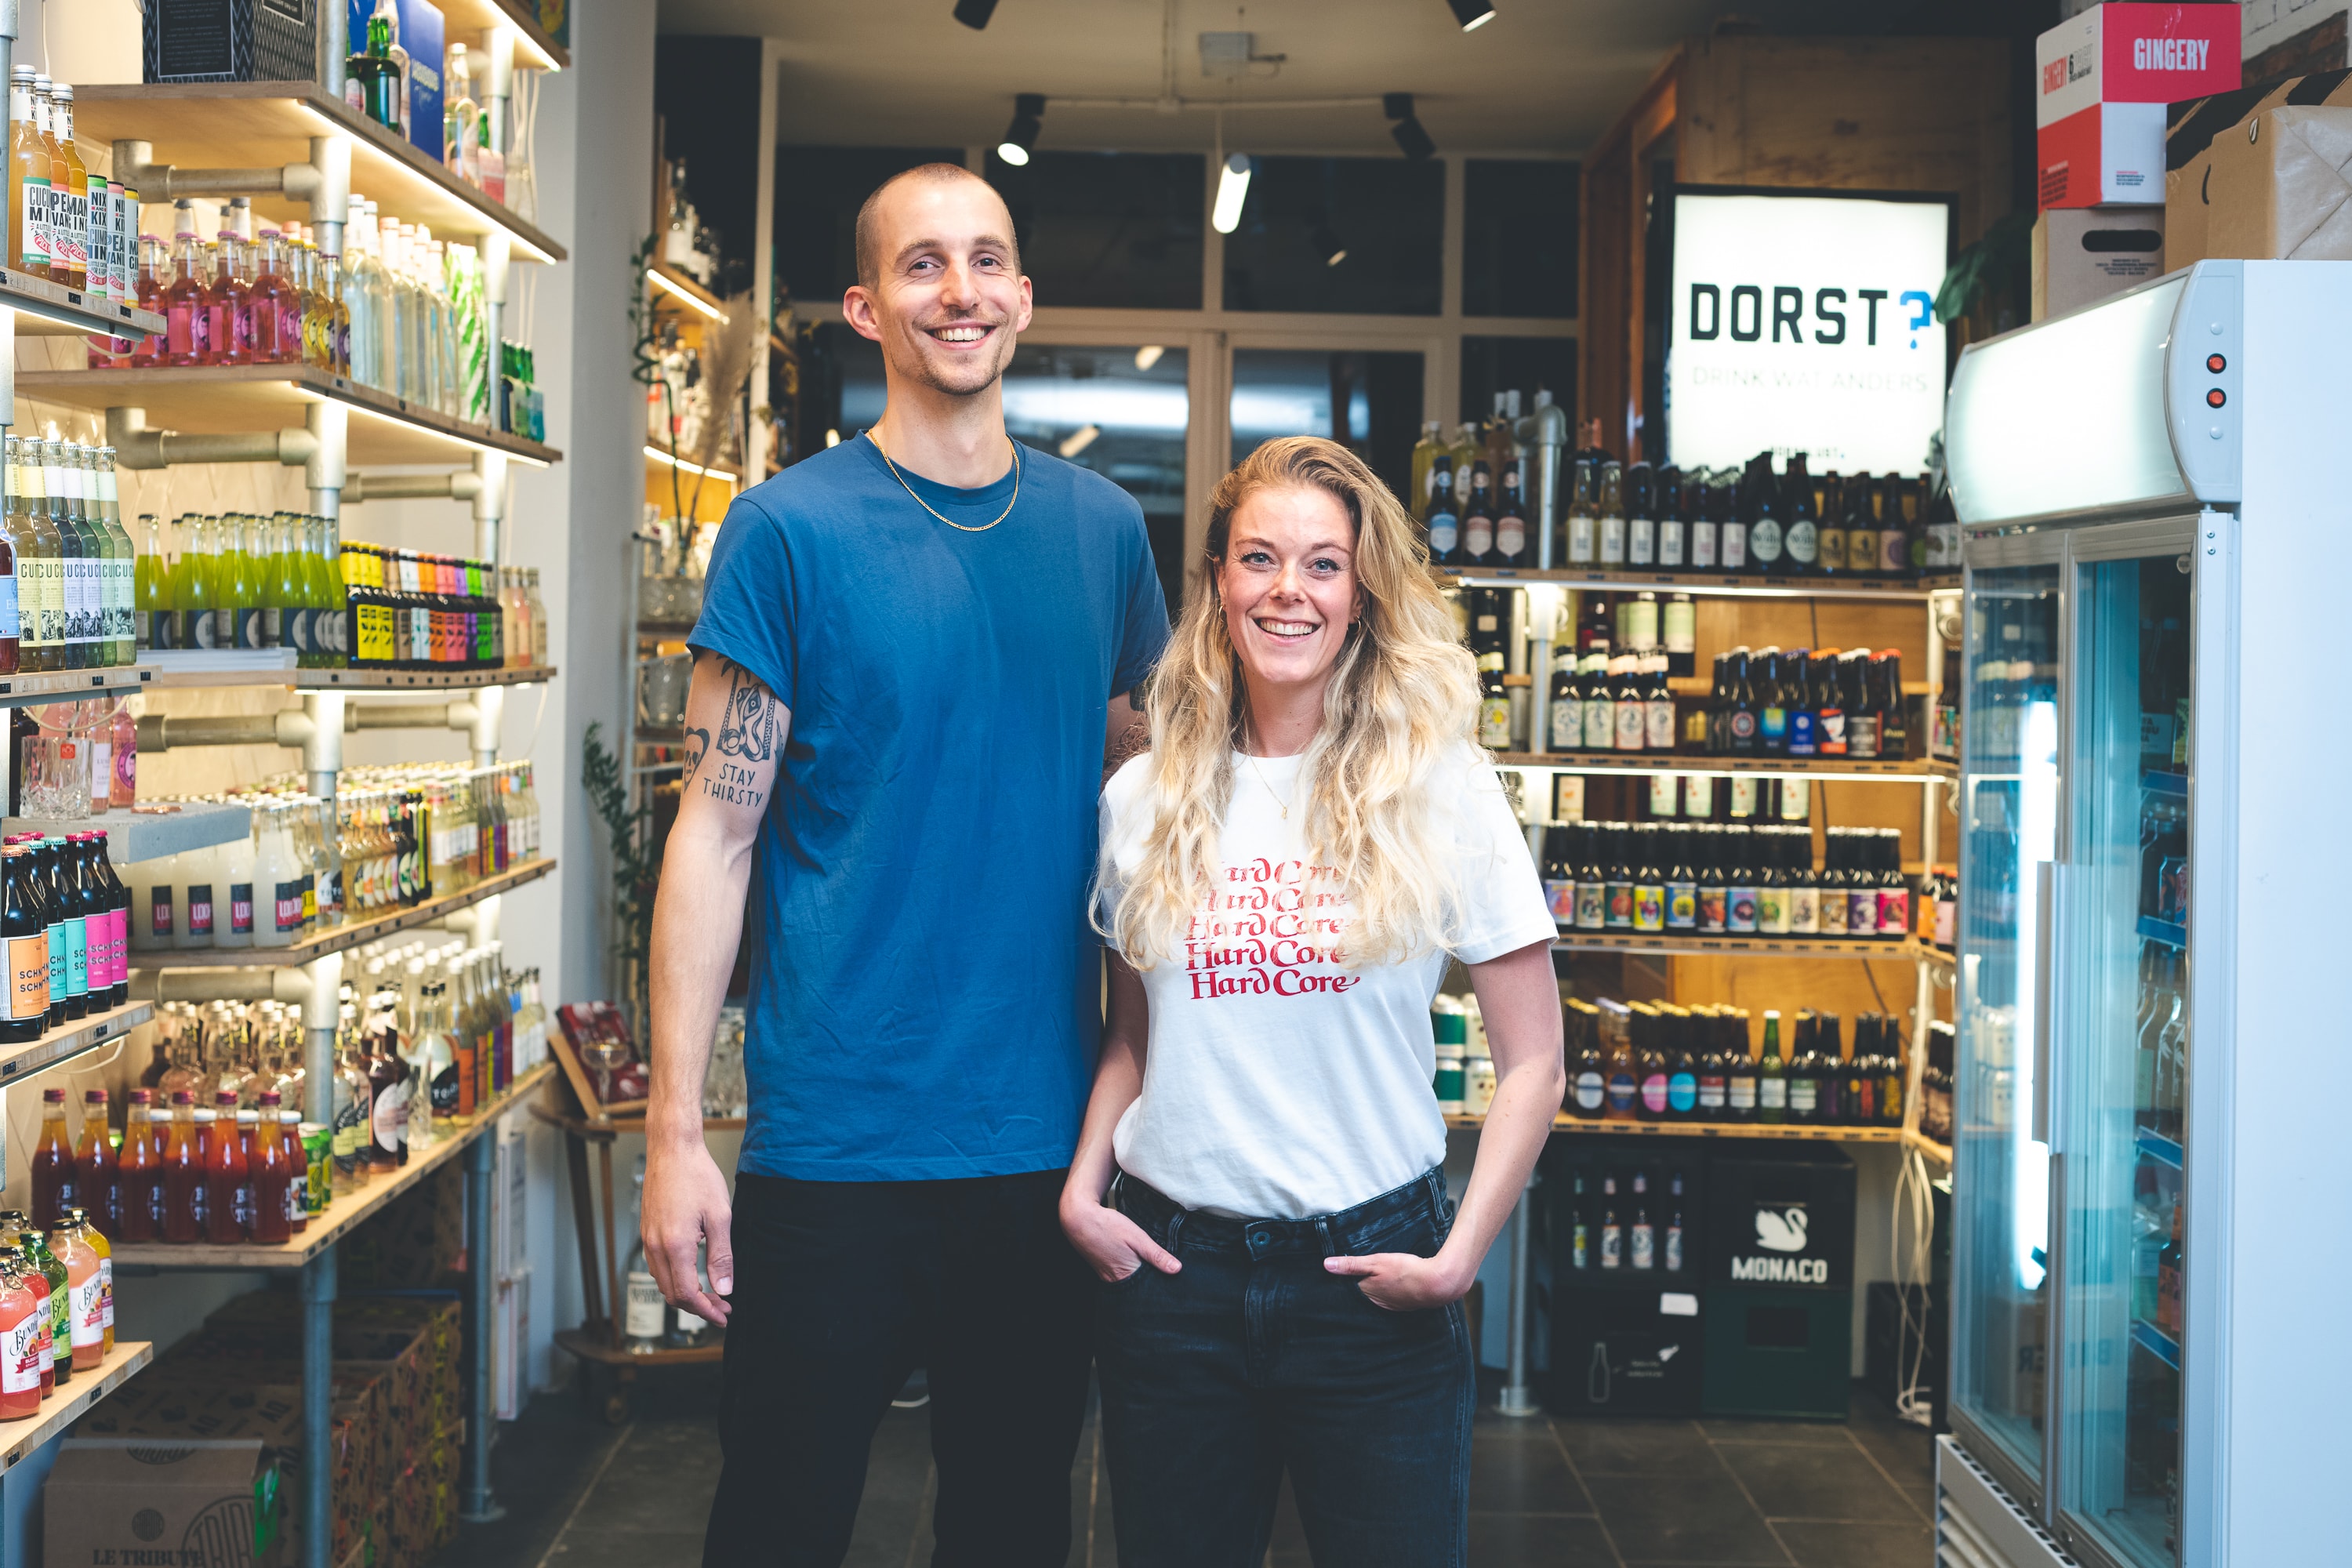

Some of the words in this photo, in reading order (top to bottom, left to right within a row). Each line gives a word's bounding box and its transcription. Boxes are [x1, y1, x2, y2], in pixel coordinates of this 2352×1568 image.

[2133, 38, 2210, 71] GINGERY
[91, 191, 107, 207] NIX
[91, 211, 107, 227] KIX
[1690, 283, 1932, 350] DORST?
[1693, 366, 1766, 388] DRINK
[1772, 369, 1821, 390] WAT
[1834, 372, 1928, 393] ANDERS
[719, 763, 756, 786] STAY
[703, 777, 764, 808] THIRSTY
[1188, 967, 1360, 1000] HardCore
[1731, 1256, 1828, 1283] MONACO
[93, 1549, 116, 1566] LE
